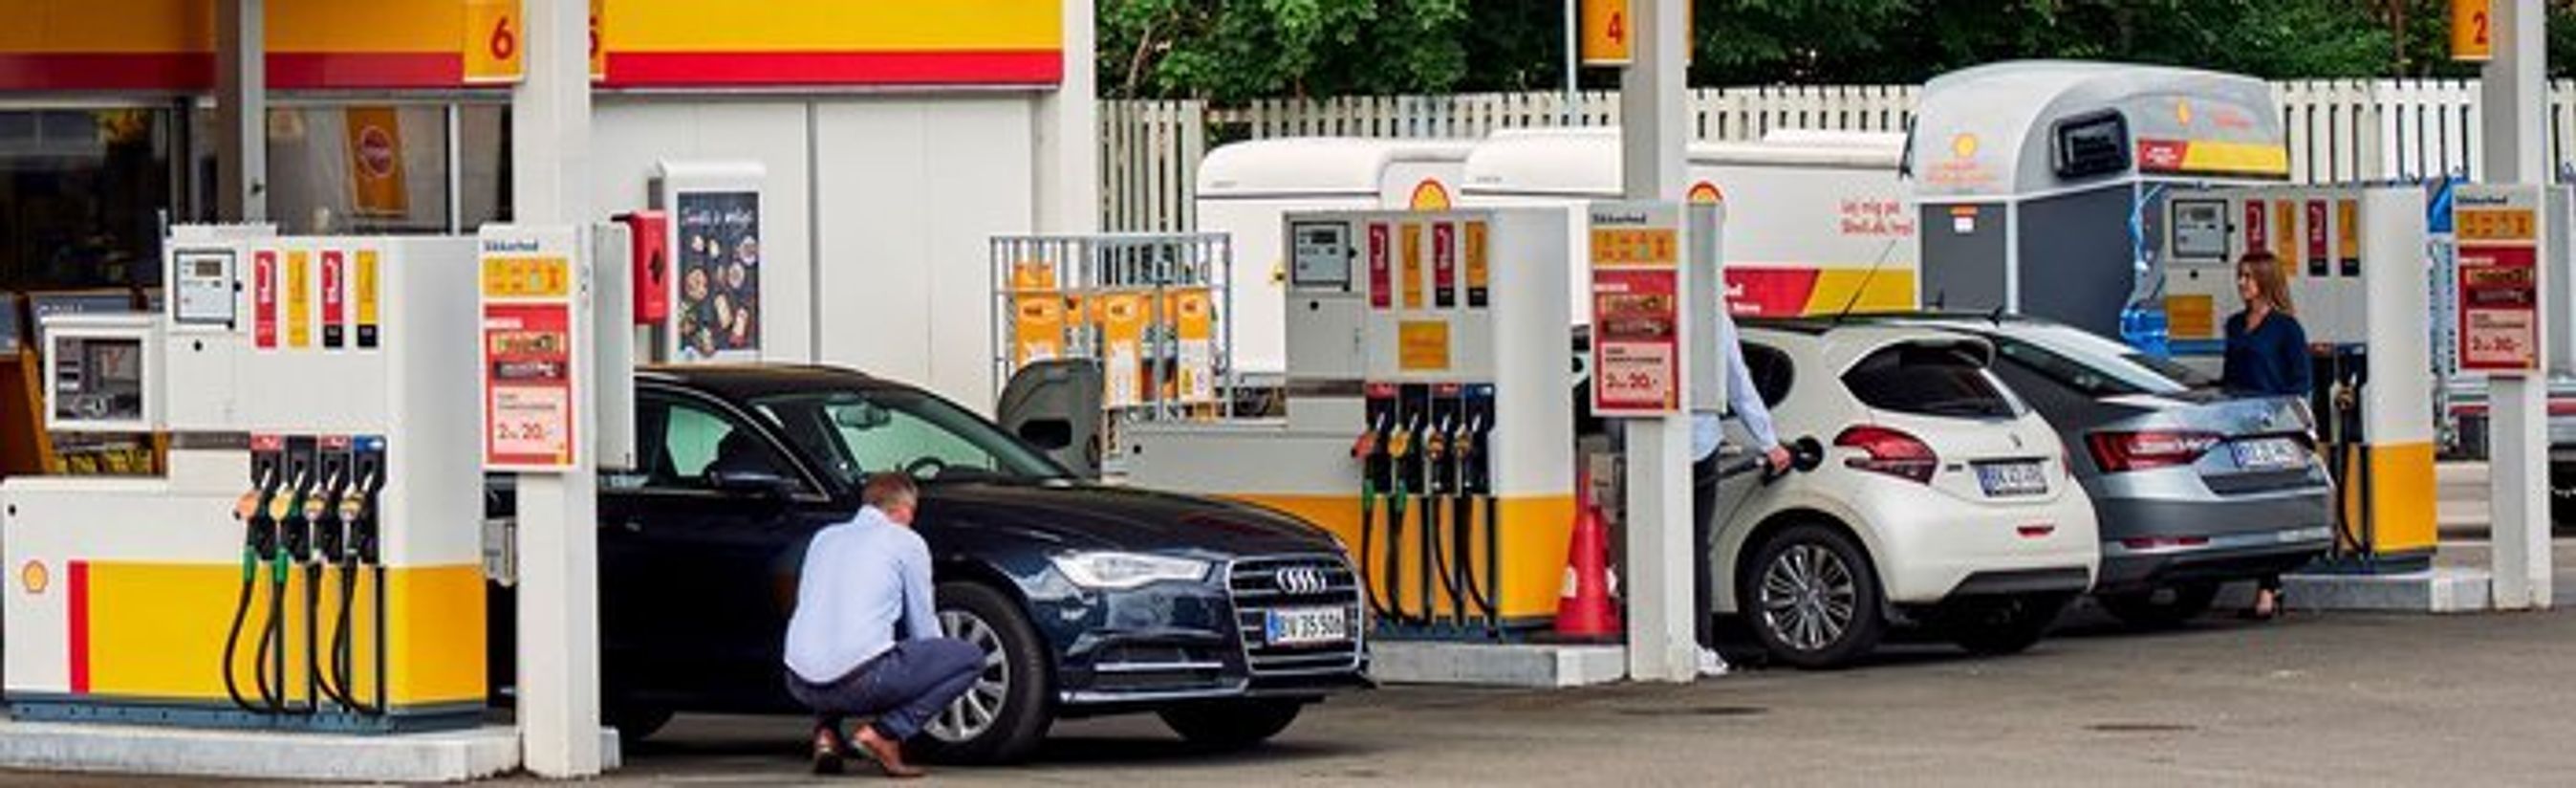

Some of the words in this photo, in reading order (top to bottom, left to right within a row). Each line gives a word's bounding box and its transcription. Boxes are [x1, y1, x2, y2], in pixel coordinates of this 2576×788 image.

[491, 15, 514, 60] 6
[1608, 11, 1622, 44] 4
[2474, 11, 2488, 45] 2
